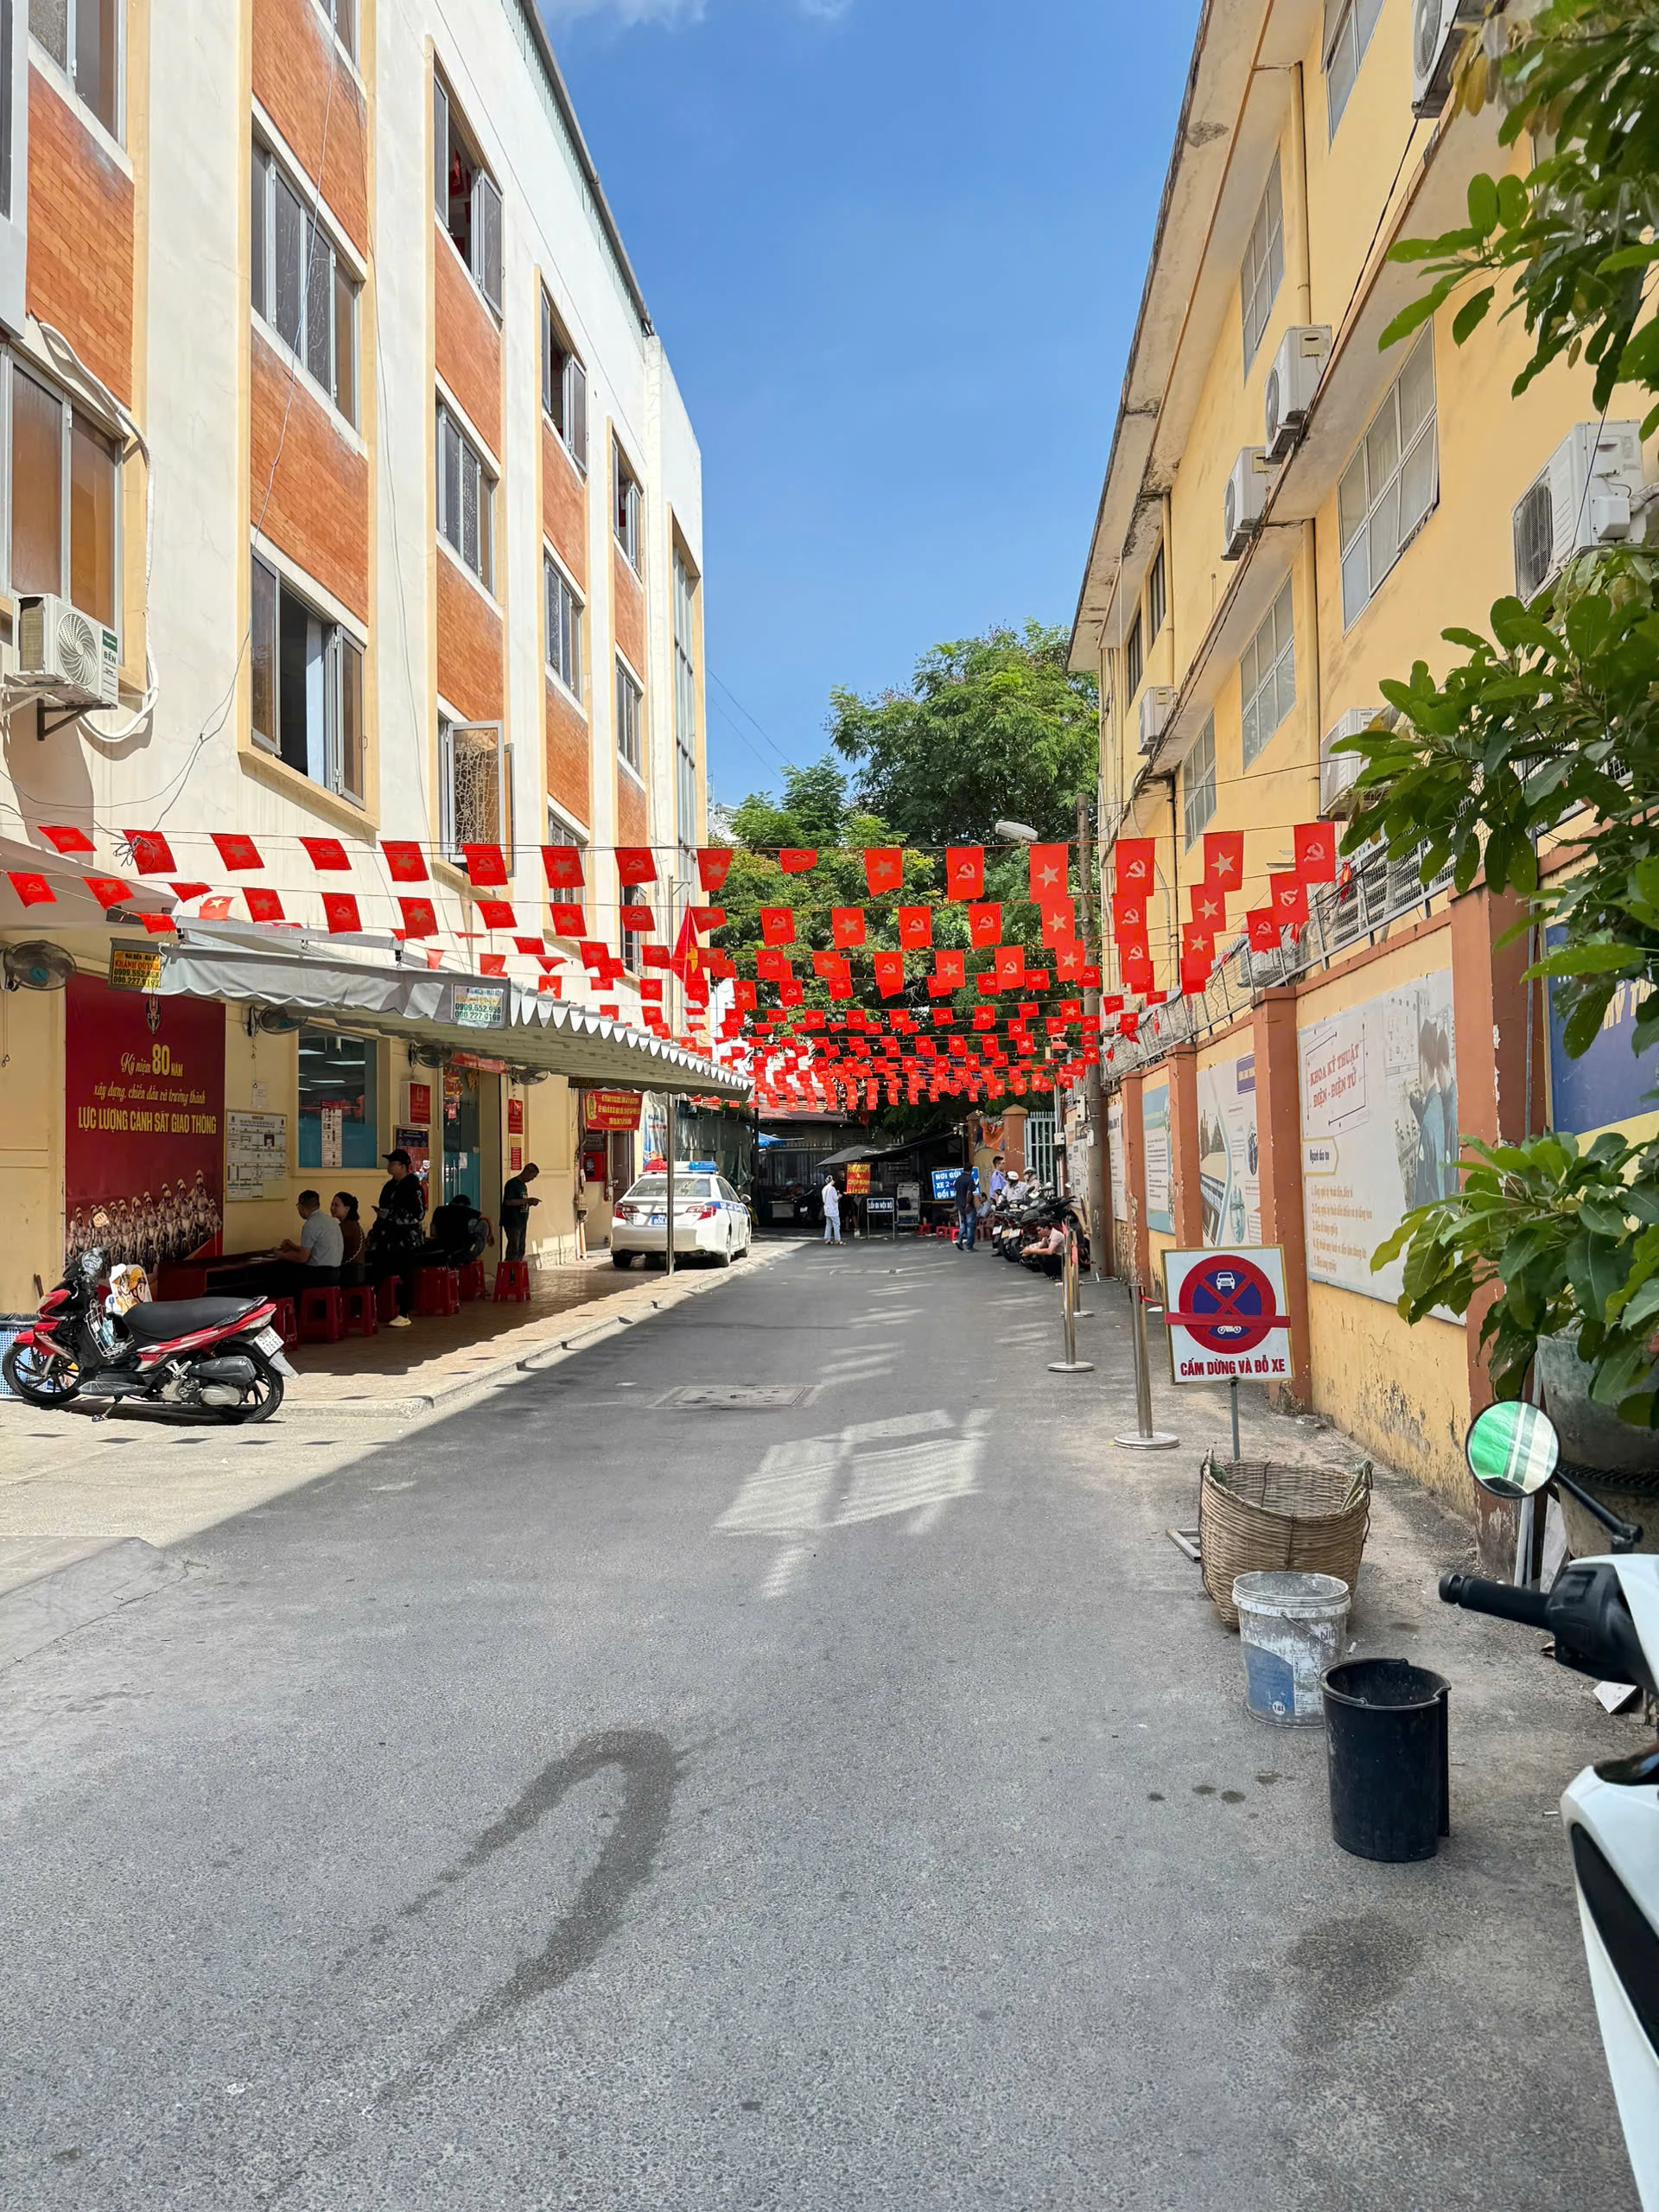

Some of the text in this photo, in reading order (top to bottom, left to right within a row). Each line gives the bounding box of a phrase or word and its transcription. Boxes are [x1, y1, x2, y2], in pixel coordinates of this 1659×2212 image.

[152, 1043, 170, 1076] 80
[1310, 1064, 1327, 1086] KHOA
[1337, 1043, 1360, 1071] THUẬT
[79, 1106, 97, 1132] LỰC
[99, 1107, 129, 1133] LƯỢNG
[130, 1107, 153, 1132] CẢNH
[154, 1110, 169, 1133] SÁT
[171, 1113, 190, 1134] GIAO
[191, 1113, 217, 1135] THÔNG
[1180, 1355, 1286, 1376] CẤM DỪNG VÀ ĐỖ XE
